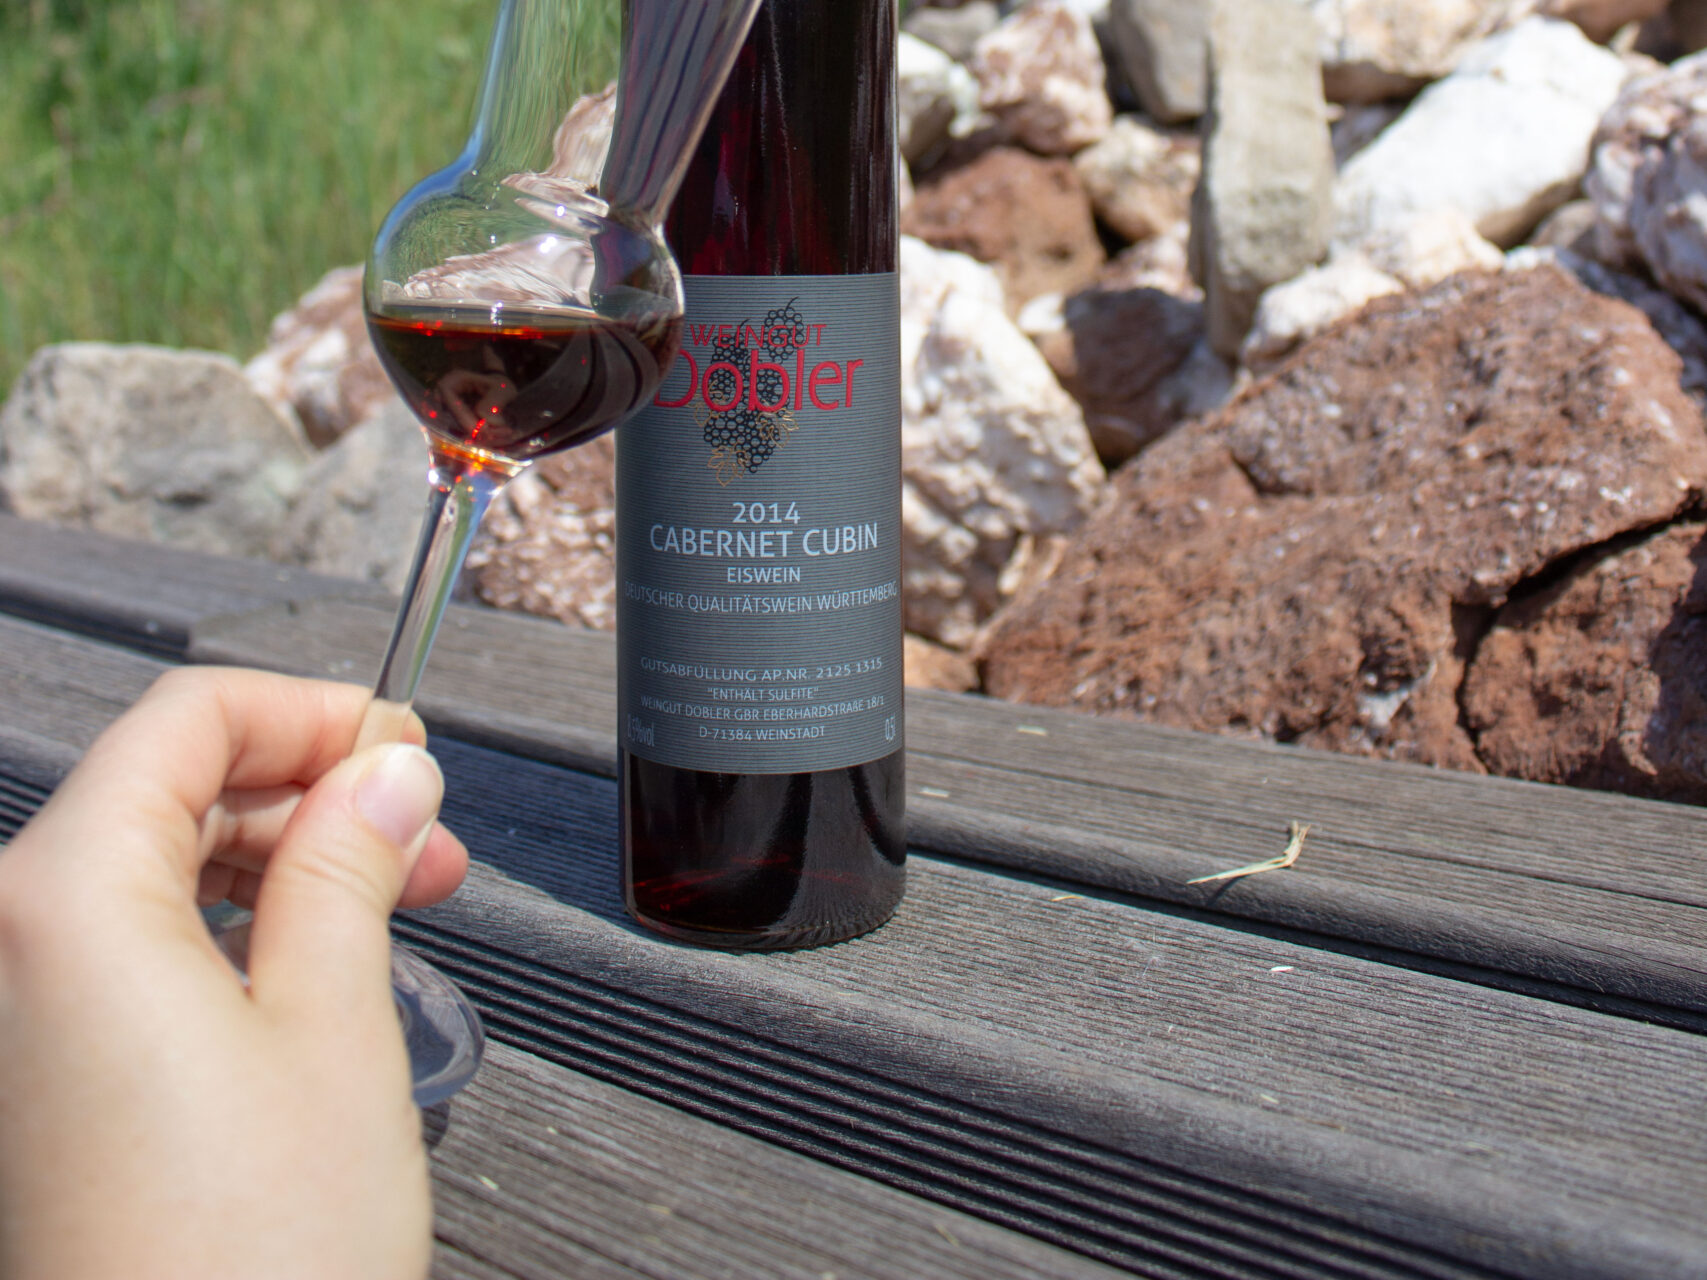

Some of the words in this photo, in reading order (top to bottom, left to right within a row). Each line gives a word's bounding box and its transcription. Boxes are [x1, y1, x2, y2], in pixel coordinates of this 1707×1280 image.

[690, 323, 827, 348] WEINGUT
[654, 348, 864, 412] Dobler
[732, 501, 801, 525] 2014
[650, 524, 794, 558] CABERNET
[802, 522, 878, 557] CUBIN
[727, 567, 801, 584] EISWEIN
[625, 581, 684, 609] DEUTSCHER
[687, 593, 812, 614] QUALITÄTSWEIN
[817, 580, 897, 611] WÜRTTEMBERG
[640, 656, 757, 681] GUTSABFÜLLUNG
[816, 664, 851, 679] 2125
[856, 657, 882, 673] 1315
[640, 696, 683, 715] WEINGUT
[685, 704, 730, 720] DOBLER
[734, 708, 759, 721] GBR
[700, 725, 752, 741] D-71384
[755, 726, 825, 740] WEINSTADT
